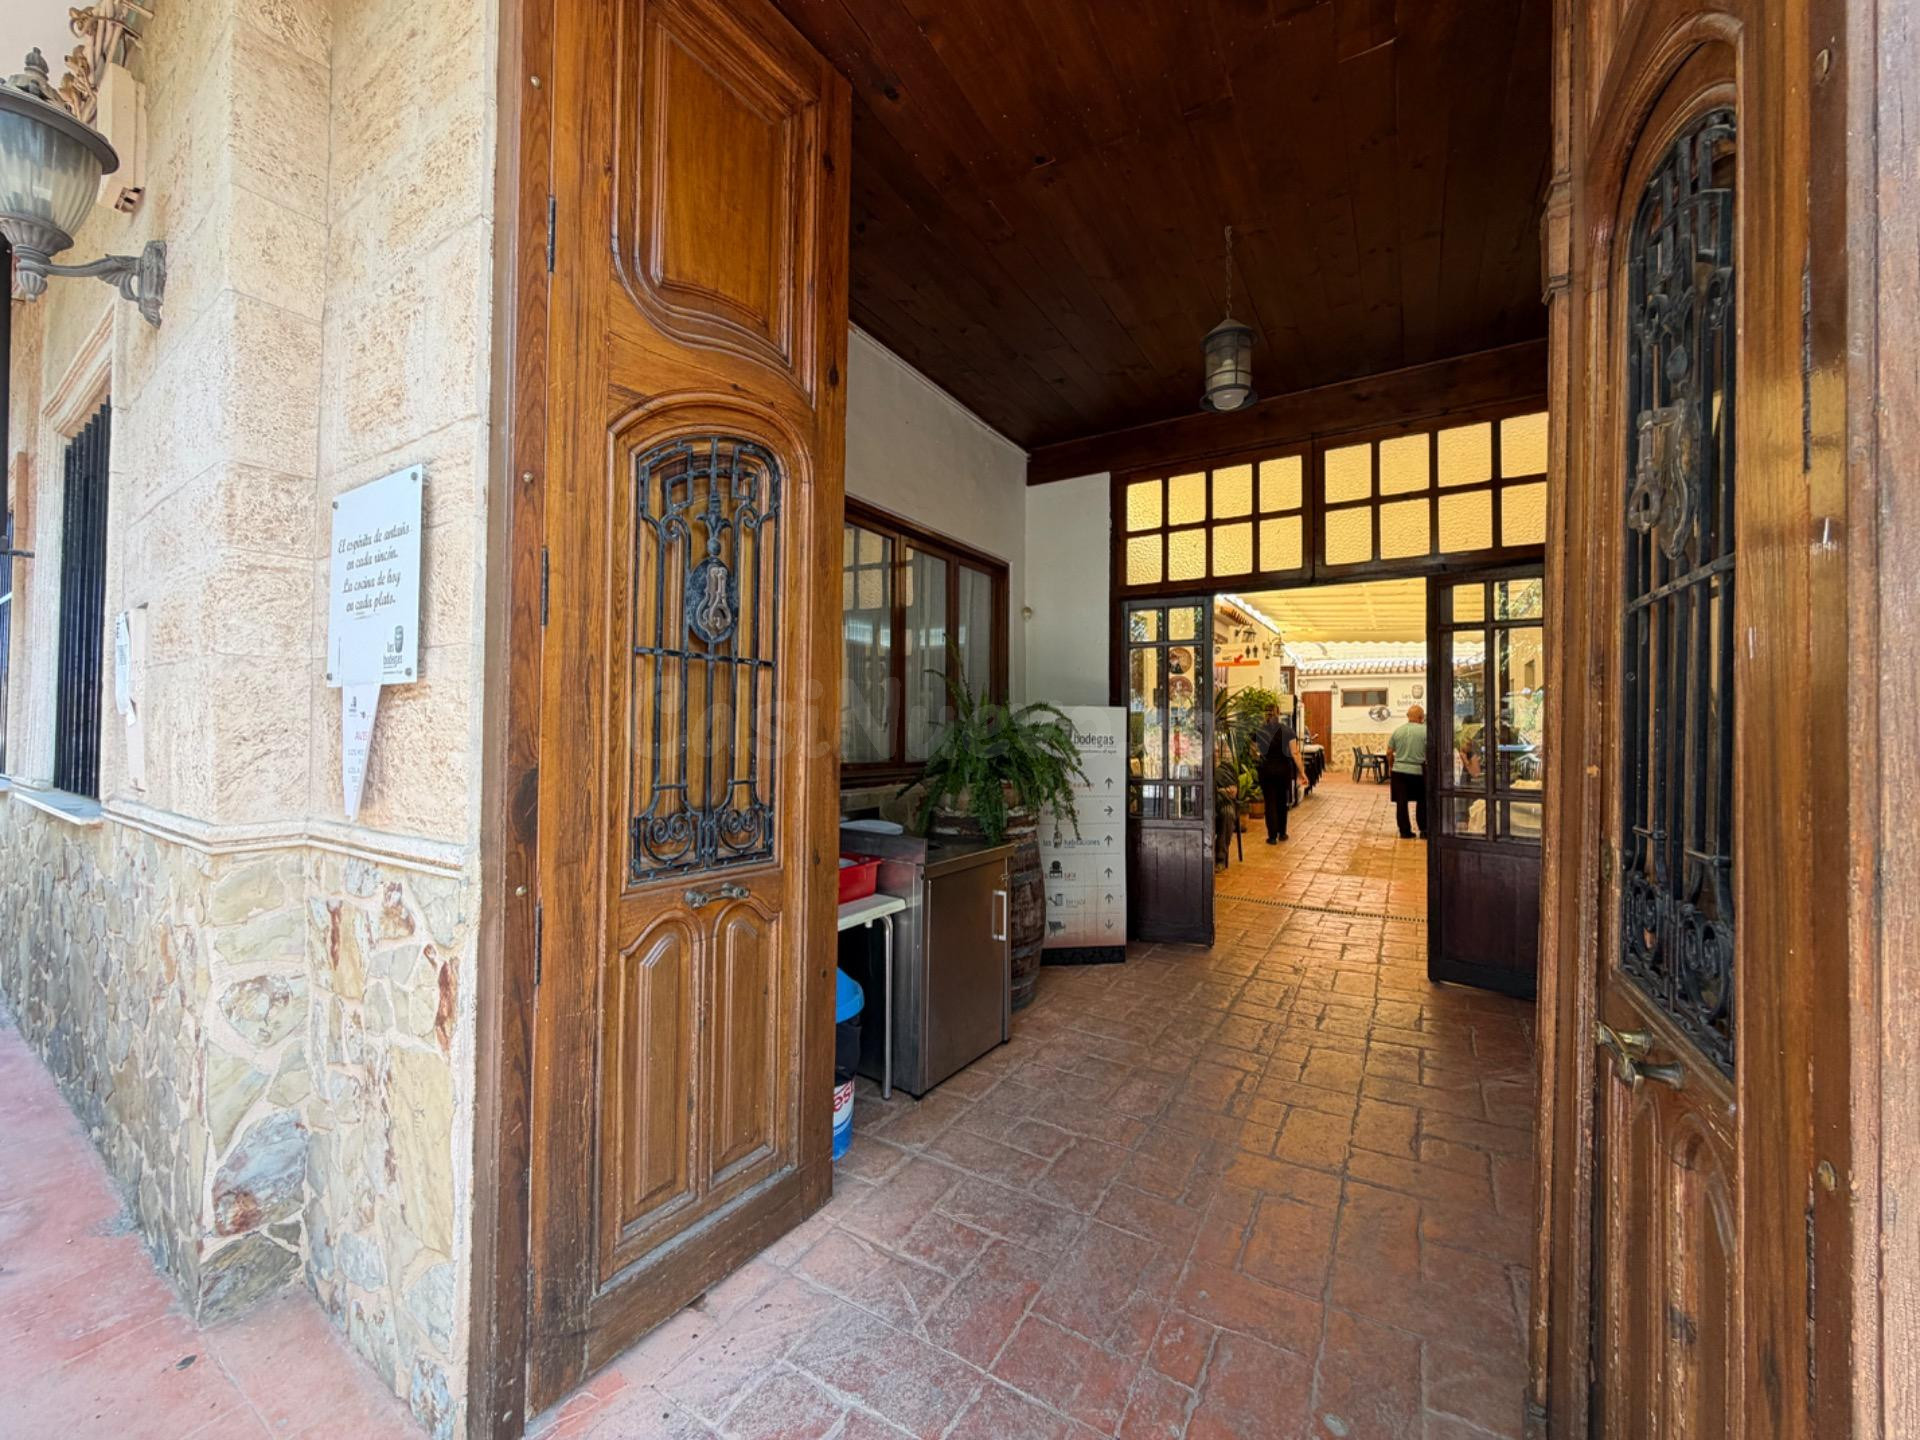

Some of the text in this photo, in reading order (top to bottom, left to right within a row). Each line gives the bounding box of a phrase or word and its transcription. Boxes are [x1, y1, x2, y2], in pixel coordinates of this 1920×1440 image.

[337, 538, 346, 554] El
[373, 527, 382, 544] de
[355, 551, 373, 568] cada
[353, 575, 375, 592] cocina
[376, 570, 386, 586] de
[386, 567, 401, 588] hoy
[355, 593, 373, 610] cada
[1074, 733, 1114, 748] bodegas
